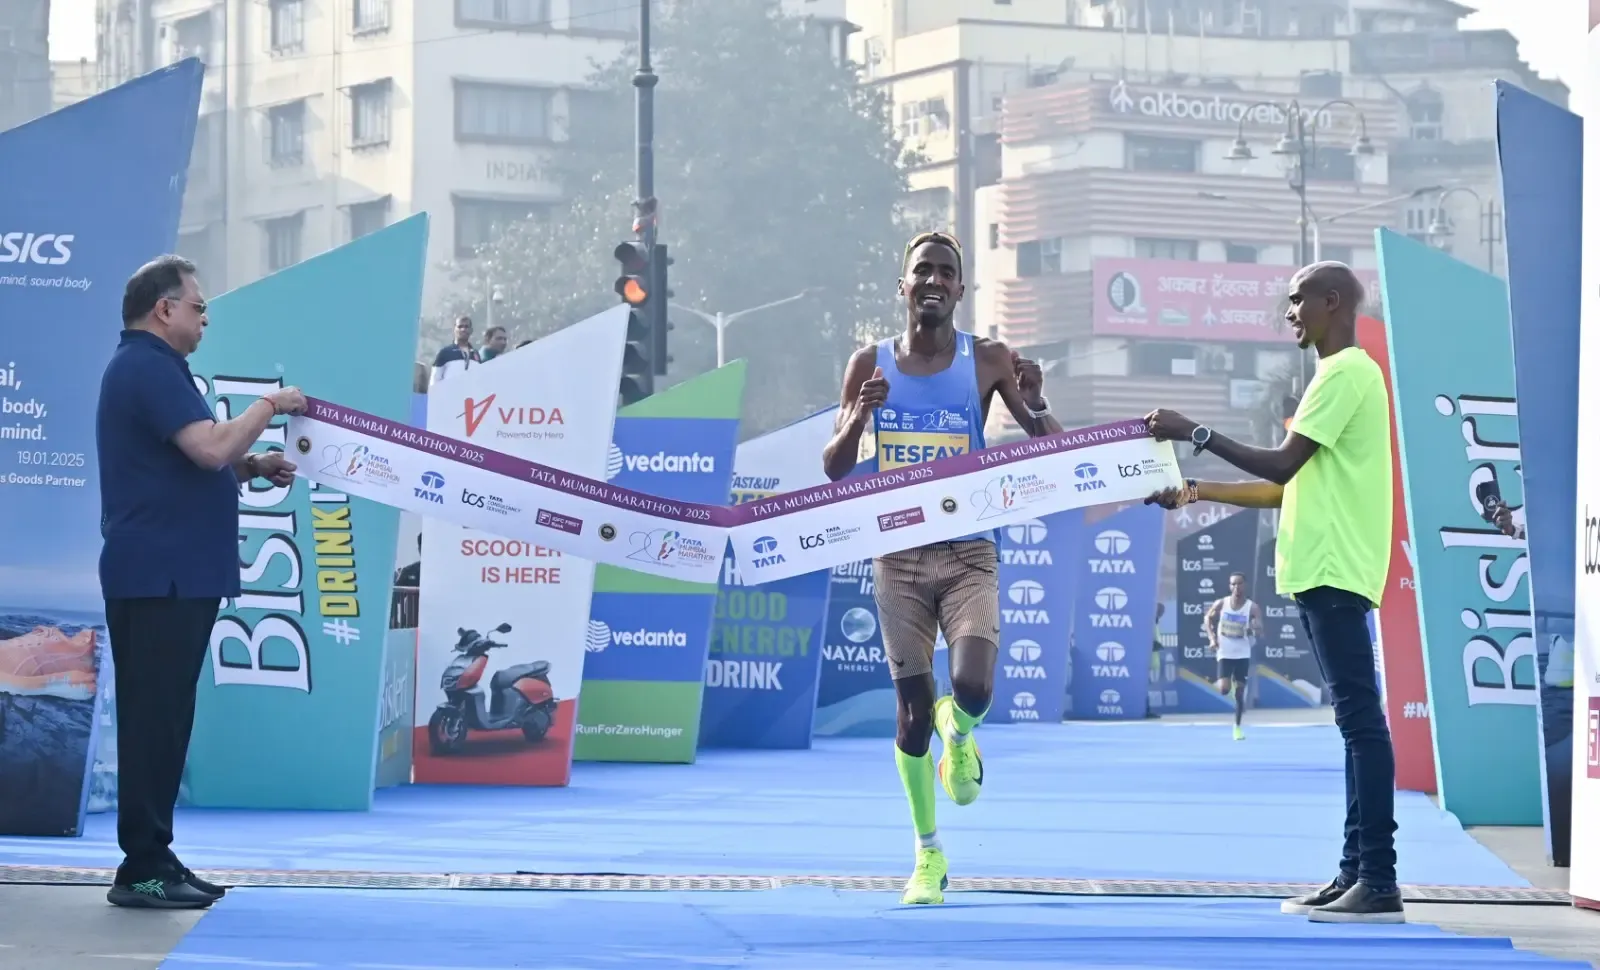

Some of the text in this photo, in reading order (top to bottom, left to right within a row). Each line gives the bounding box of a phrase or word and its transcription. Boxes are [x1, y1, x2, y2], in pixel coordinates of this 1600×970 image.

[1139, 91, 1332, 129] akbartravelsom
[0, 232, 75, 265] SICS
[30, 276, 64, 288] sound
[64, 277, 92, 291] body
[1157, 276, 1207, 294] अकबर
[2, 397, 48, 419] body,
[498, 407, 564, 425] VIDA
[0, 422, 47, 441] mind.
[880, 421, 899, 429] TATA
[315, 404, 485, 463] TATA MUMBAI MARATHON 2025
[496, 430, 564, 440] Powered by Hero
[977, 424, 1148, 466] TATA MUMBAI MARATHON 202
[17, 451, 85, 467] 19.01.2025
[370, 453, 389, 465] TATA
[625, 451, 715, 473] vedanta
[365, 467, 400, 482] MARATHON
[1117, 463, 1142, 478] tcs
[8, 472, 43, 485] Goods
[45, 474, 86, 487] Partner
[732, 475, 780, 490] AST&UP
[1016, 473, 1038, 483] TATA
[1017, 478, 1045, 489] MUMBAI
[751, 502, 781, 517] TATA
[784, 488, 833, 509] MUMBAI
[836, 472, 905, 497] MARATHON
[908, 466, 934, 481] 2025
[1019, 482, 1057, 497] MARATHON
[1074, 479, 1107, 492] TATA
[414, 487, 444, 504] TATA
[461, 488, 486, 508] tcs
[489, 494, 503, 503] TATA
[530, 467, 711, 521] TATA MUMBAI MARATHON 2025
[486, 505, 508, 515] SERVICES
[487, 500, 522, 513] CONSULTANCY
[551, 516, 580, 528] IDFC FIRST
[893, 510, 921, 522] IDFC FIRST
[551, 521, 564, 530] Bank
[825, 525, 841, 533] TATA
[894, 519, 908, 528] Bank
[826, 526, 861, 539] CONSULTANCY
[827, 534, 850, 545] SERVICES
[681, 537, 702, 547] TATA
[799, 532, 825, 550] tcs
[677, 550, 716, 561] MARATHON
[679, 544, 707, 554] MUMBAI
[309, 480, 360, 646] #DRINKI
[752, 553, 786, 569] TATA
[1001, 549, 1053, 565] TATA
[1088, 559, 1136, 574] TATA
[1182, 559, 1201, 571] tcs
[482, 567, 561, 584] IS HERE
[1183, 602, 1202, 615] tcs
[1266, 605, 1284, 618] tcs
[1001, 609, 1050, 624] TATA
[1089, 614, 1133, 628] TATA
[612, 628, 687, 647] vedanta
[710, 624, 813, 658] ENERGY
[1184, 646, 1203, 658] tcs
[1266, 646, 1284, 658] tcs
[706, 659, 783, 691] DRINK
[838, 663, 876, 673] ENERGY
[1003, 665, 1047, 679] TATA
[1091, 665, 1131, 678] TATA
[1009, 709, 1039, 720] TATA
[1096, 705, 1123, 715] TATA
